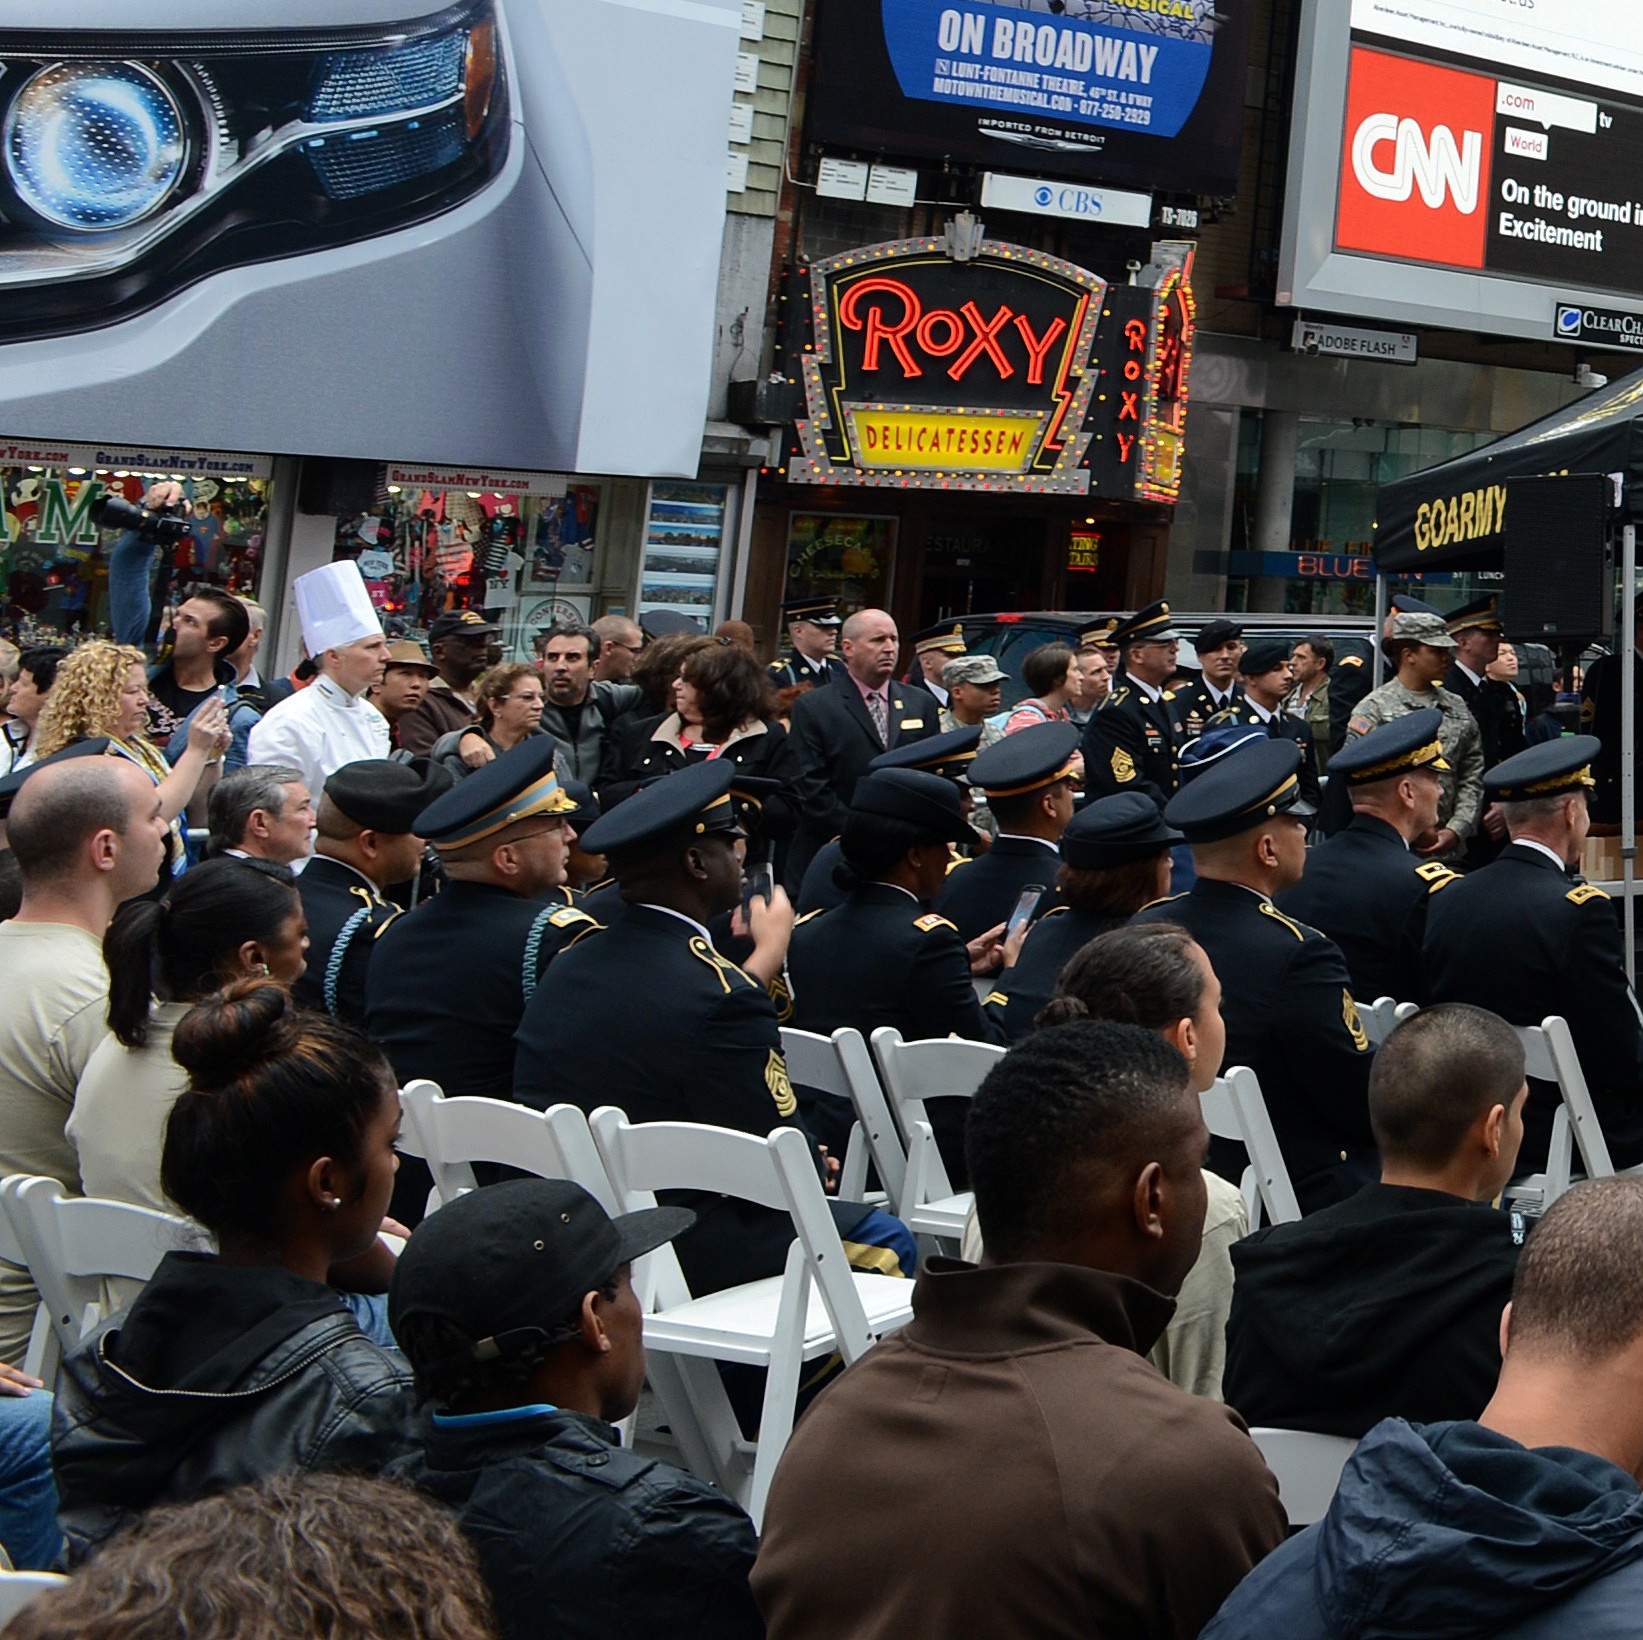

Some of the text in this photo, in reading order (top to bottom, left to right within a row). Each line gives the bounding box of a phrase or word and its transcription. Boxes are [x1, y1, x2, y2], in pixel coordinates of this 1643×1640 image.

[938, 9, 1159, 84] ON BROADWAY
[951, 60, 1041, 89] LUNT-FONTANNE
[978, 117, 1032, 133] IMPORTED
[1501, 90, 1535, 112] .com
[1599, 111, 1613, 131] tv
[1510, 133, 1543, 155] World
[1351, 112, 1483, 215] CNN
[1058, 189, 1103, 217] CBS
[1161, 206, 1198, 229] TS-7026
[1501, 178, 1530, 205] On
[1533, 183, 1563, 210] the
[1567, 192, 1632, 226] ground
[1499, 212, 1603, 253] Excitement
[839, 277, 1066, 385] ROXY
[1317, 333, 1396, 355] ADOBE FLASH
[1117, 318, 1148, 463] ROXY
[866, 424, 1024, 456] DELICATESSEN
[1298, 555, 1371, 579] BLUE
